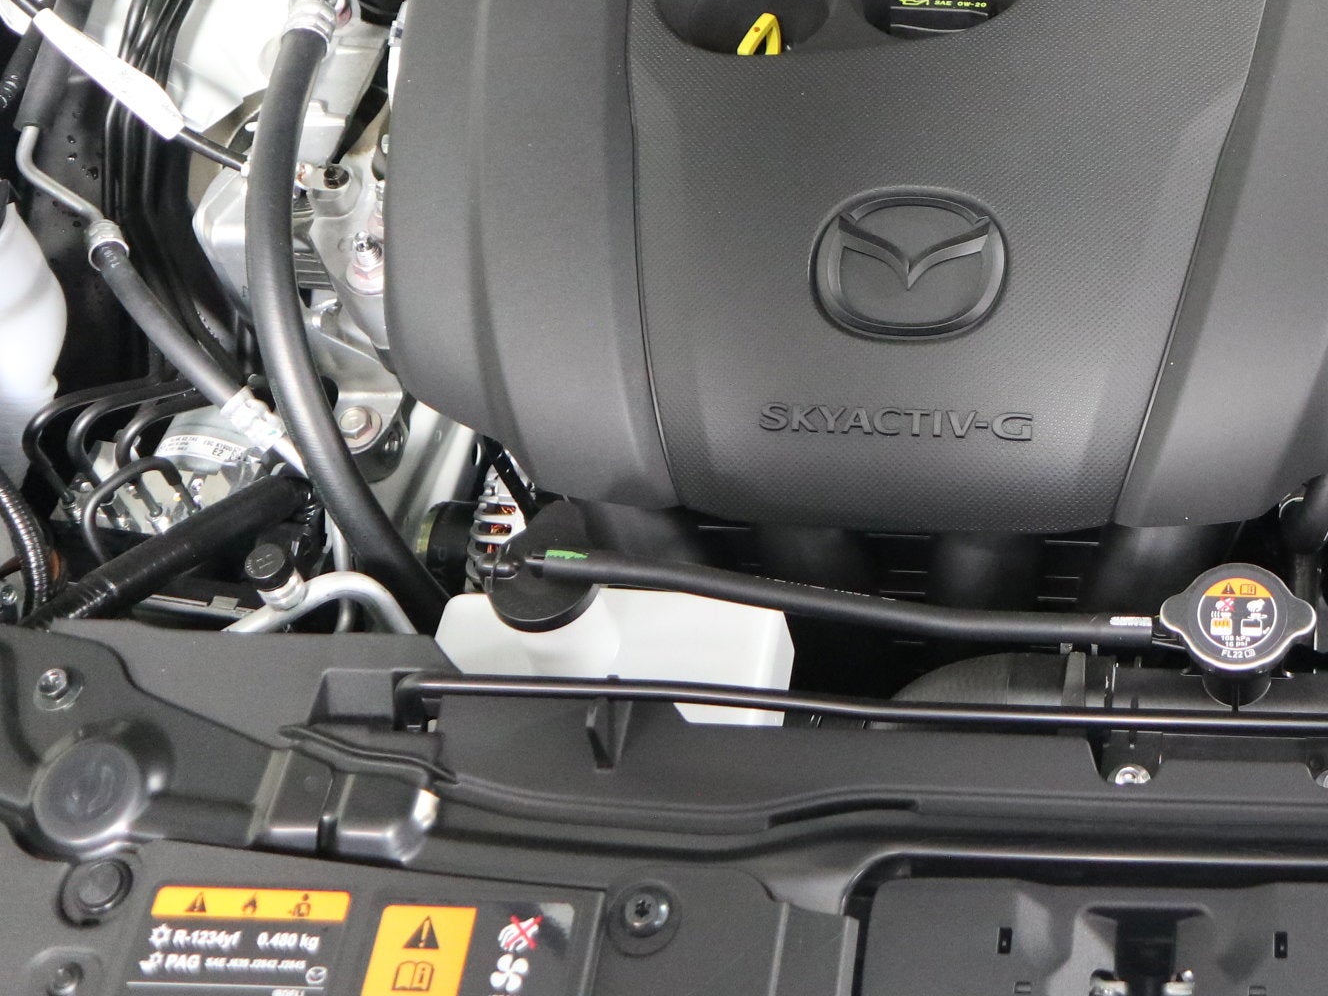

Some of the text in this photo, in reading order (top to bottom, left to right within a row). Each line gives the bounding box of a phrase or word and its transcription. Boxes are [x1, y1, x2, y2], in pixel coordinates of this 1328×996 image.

[758, 402, 1034, 442] SKYACTIV-G
[1221, 649, 1243, 658] FL22
[172, 929, 242, 950] R-1234yf
[298, 933, 321, 953] kg
[164, 954, 201, 973] PAG
